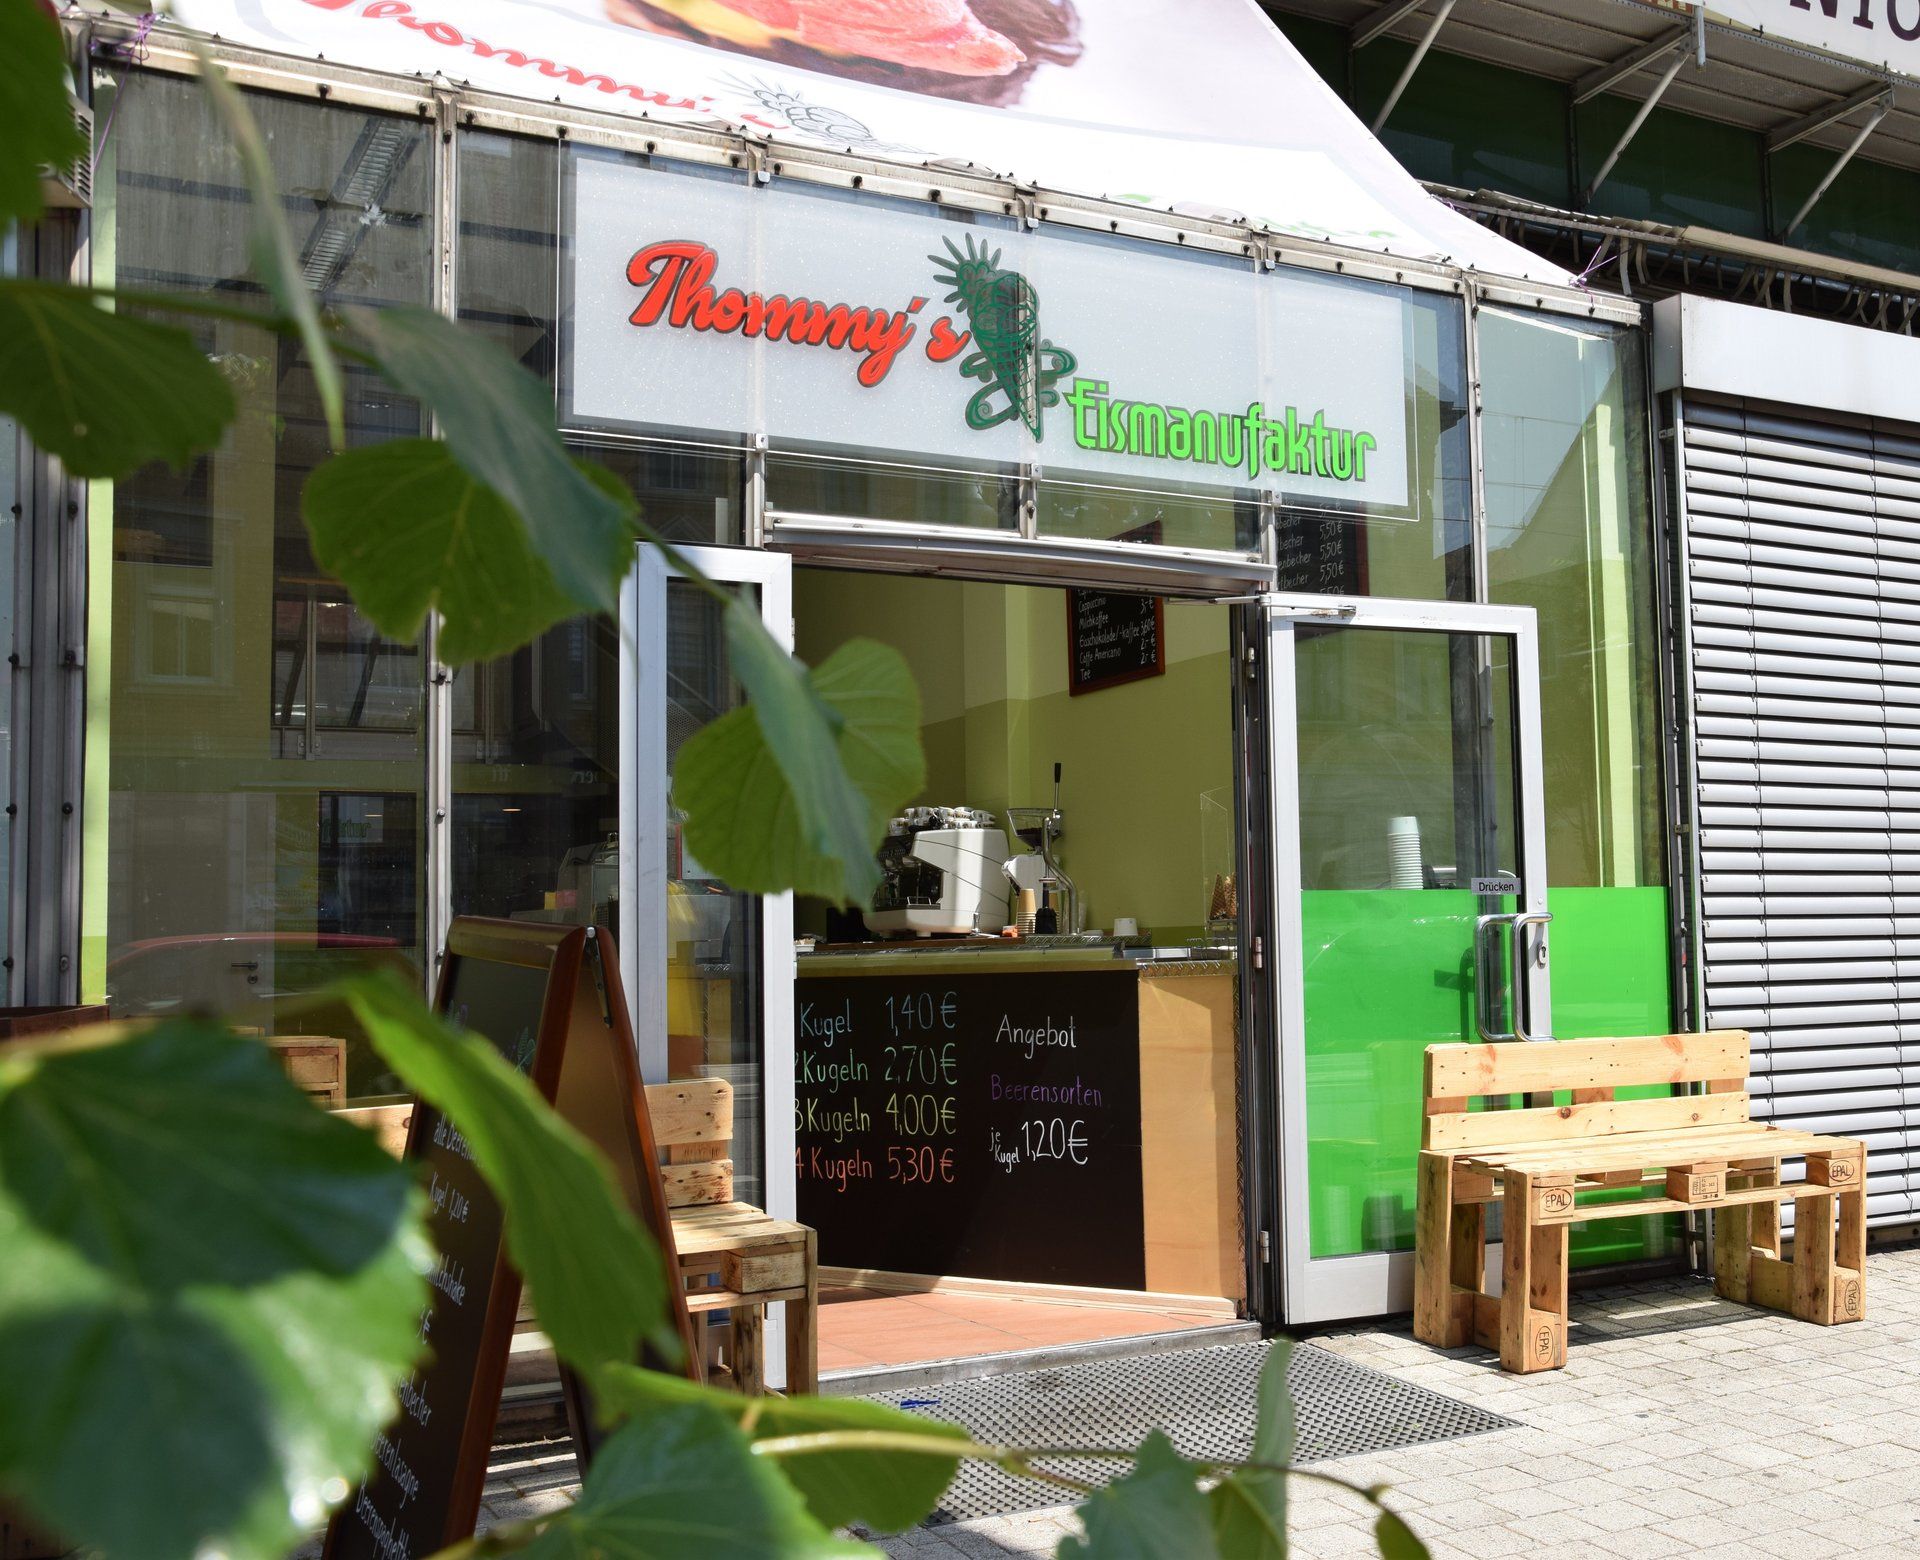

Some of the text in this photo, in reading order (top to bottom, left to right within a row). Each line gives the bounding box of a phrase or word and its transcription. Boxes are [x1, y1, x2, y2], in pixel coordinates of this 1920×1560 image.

[1062, 377, 1377, 482] Eismanufaktur
[1478, 881, 1515, 892] Drücken
[800, 998, 852, 1047] Kugel
[996, 1014, 1077, 1059] Angebot
[991, 1074, 1102, 1107] Beerensorten
[989, 1127, 1001, 1151] je
[812, 1146, 873, 1192] Kugeln
[994, 1144, 1020, 1173] Kugel
[1831, 1164, 1851, 1178] EPAL
[1545, 1193, 1568, 1208] EPAL
[1847, 1283, 1857, 1312] EPAL
[1538, 1331, 1550, 1358] EPAL
